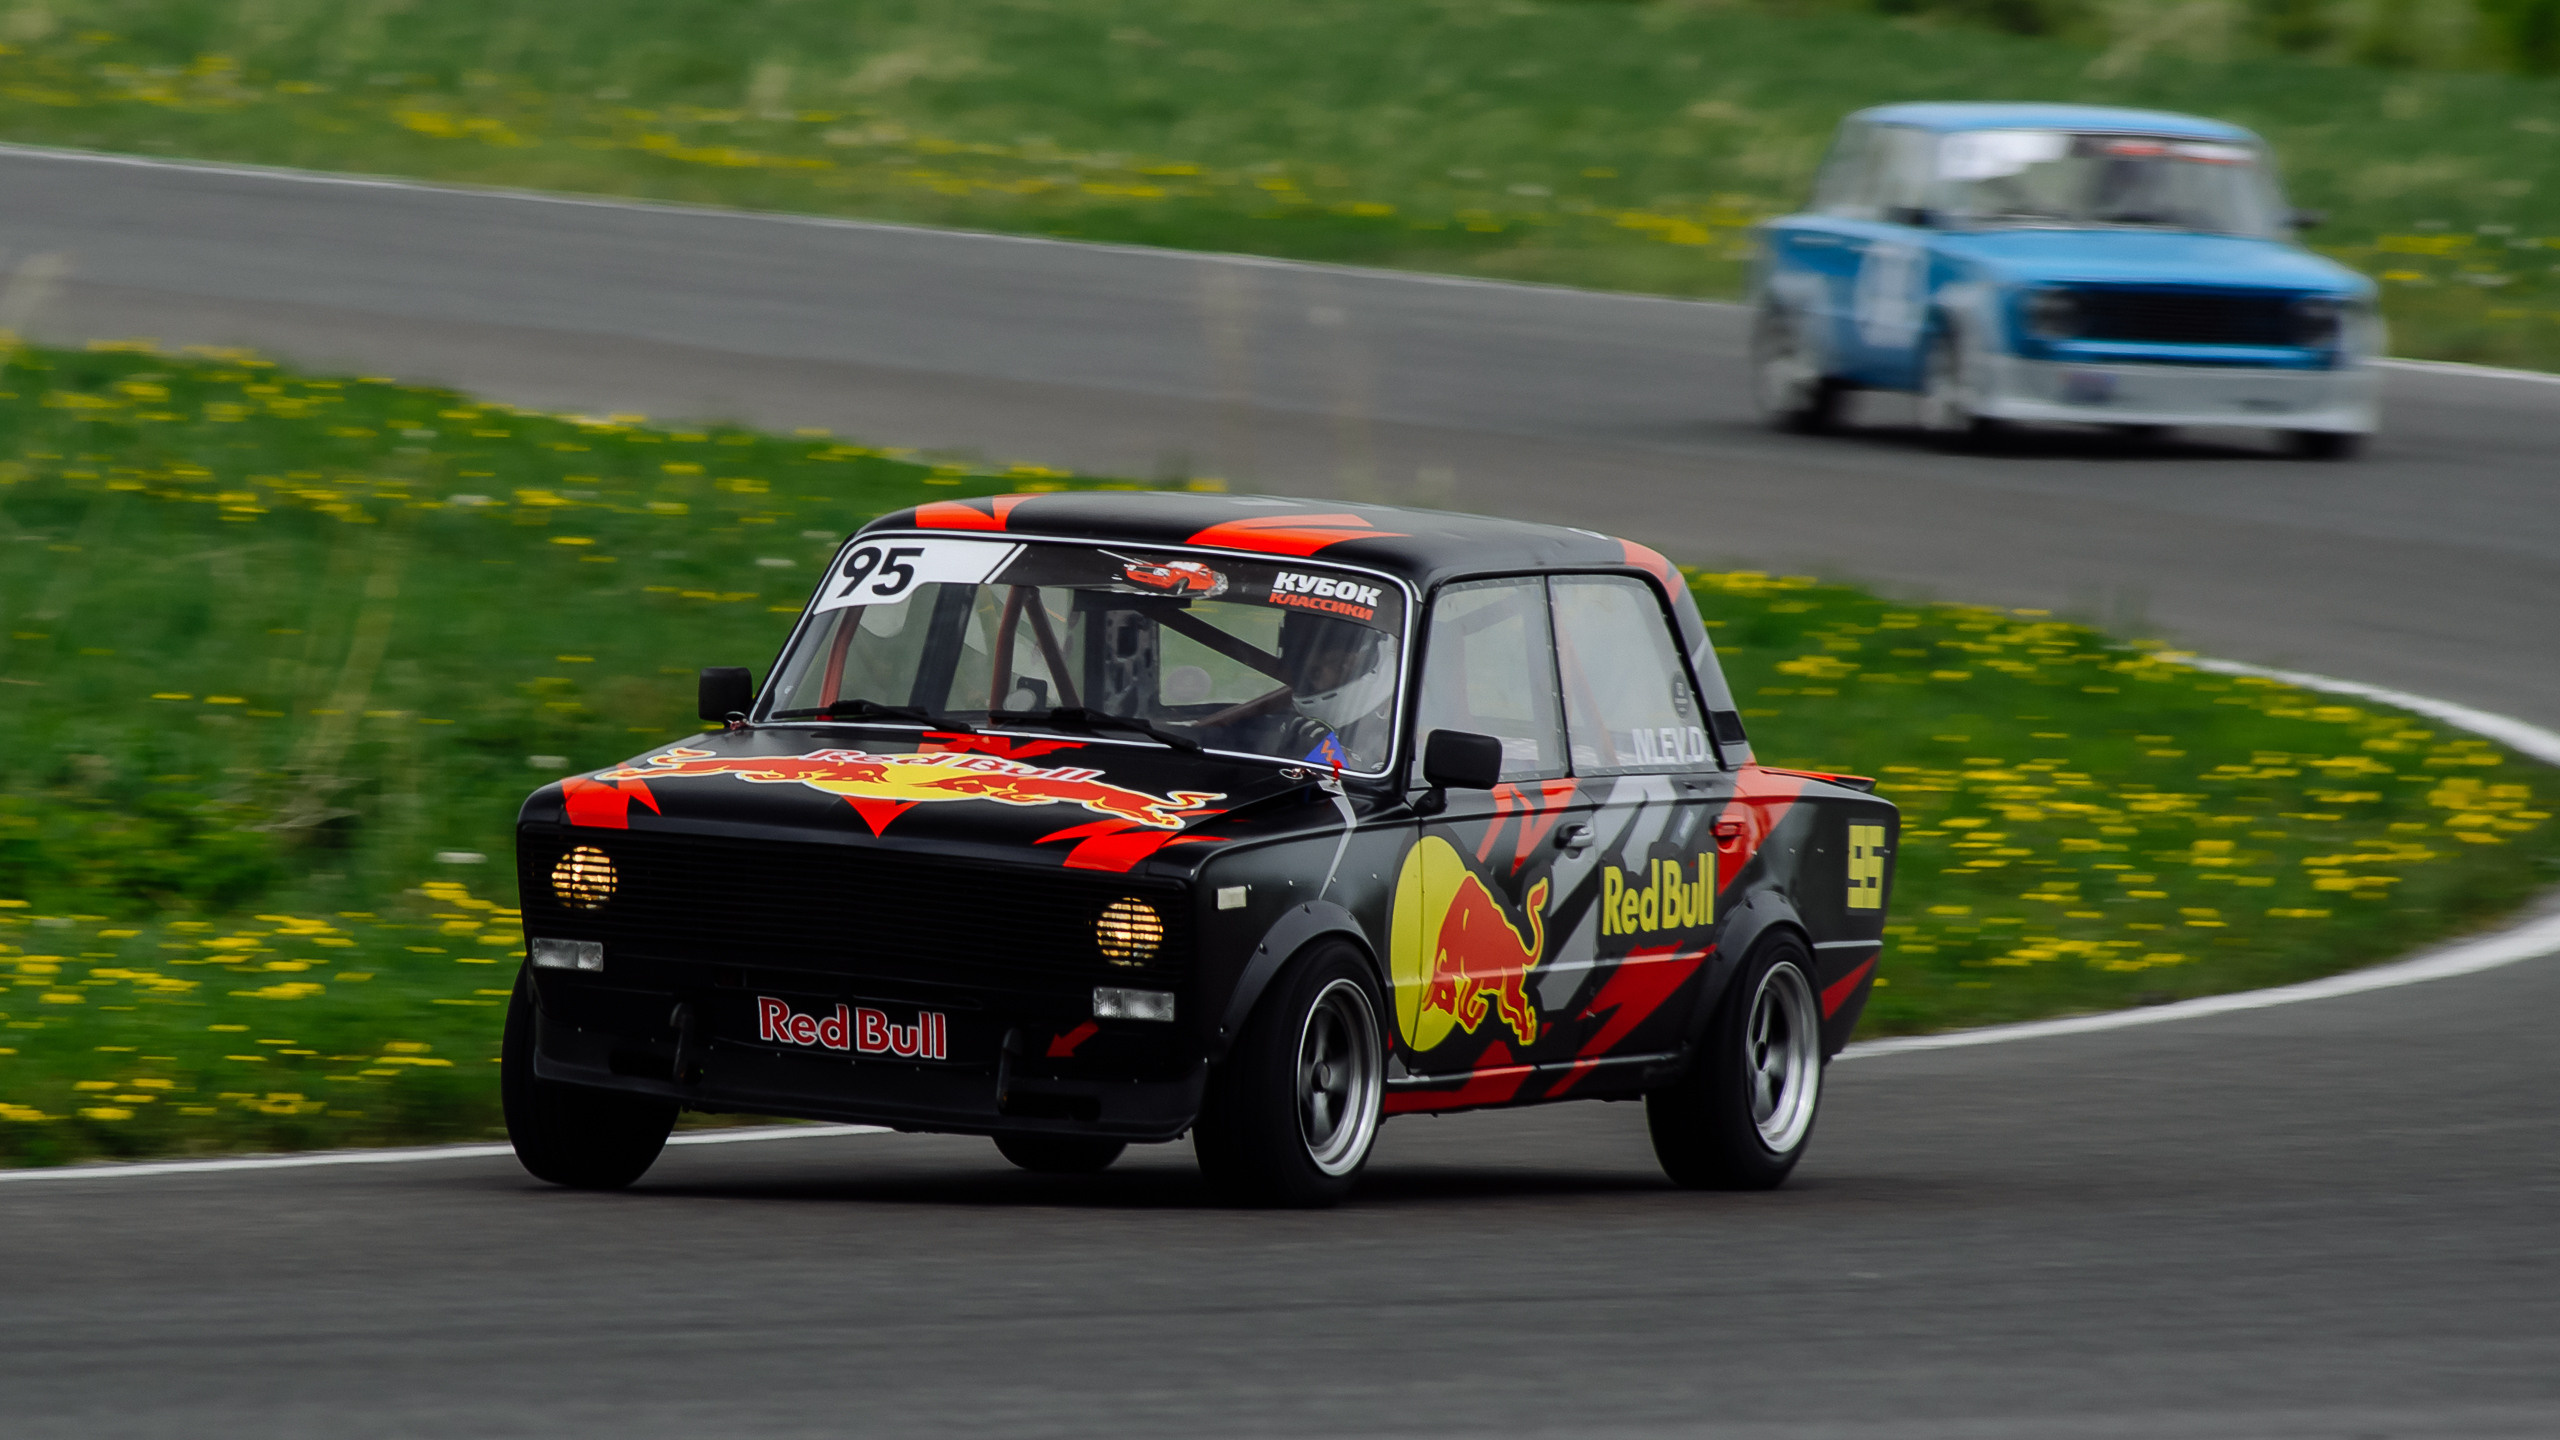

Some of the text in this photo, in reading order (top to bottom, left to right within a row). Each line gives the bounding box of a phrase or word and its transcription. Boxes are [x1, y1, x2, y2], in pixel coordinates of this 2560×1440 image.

[836, 546, 925, 598] 95
[1273, 571, 1382, 607] КУБОК
[1268, 592, 1374, 621] КЛАССИКИ
[802, 748, 1105, 782] Red Bull
[1847, 825, 1885, 909] 95
[1602, 851, 1715, 936] Red Bull
[758, 996, 946, 1060] Red Bull
